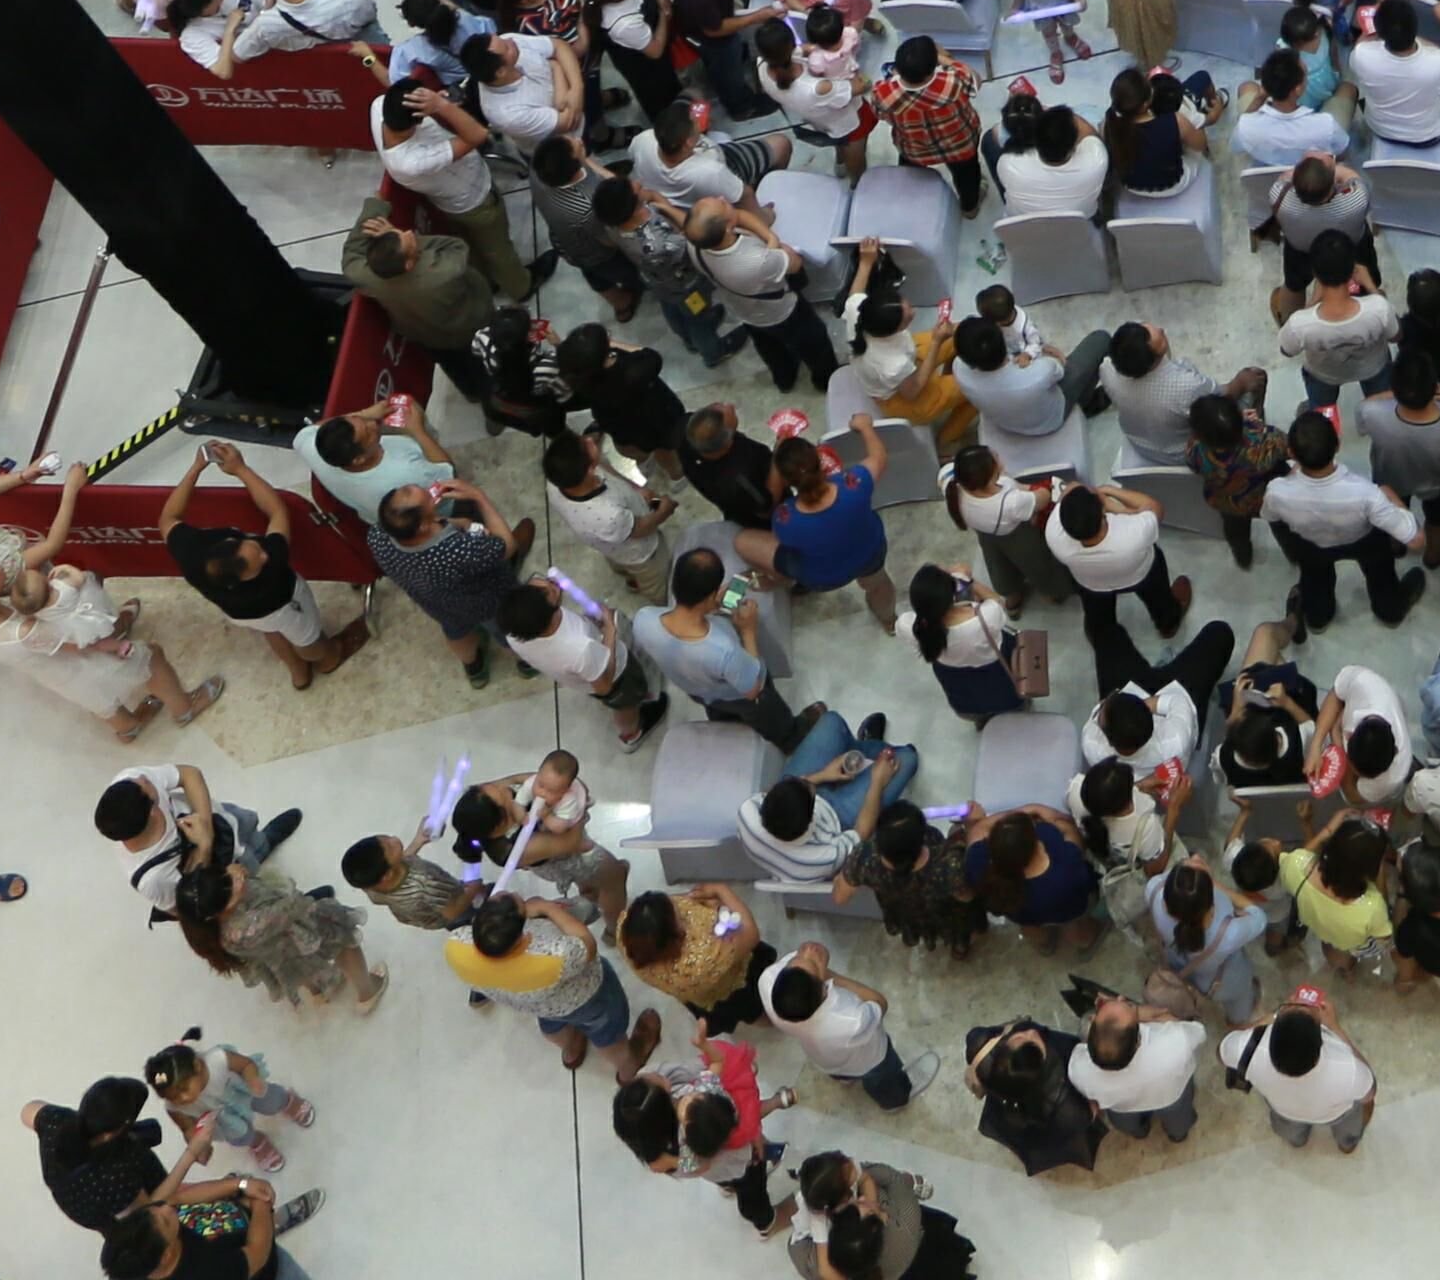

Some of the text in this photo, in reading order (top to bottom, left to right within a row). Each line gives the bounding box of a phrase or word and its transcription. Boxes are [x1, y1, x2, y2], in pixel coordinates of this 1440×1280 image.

[190, 86, 344, 105] 万达广场
[203, 101, 347, 111] WANDA PLAZA
[47, 524, 162, 541] 万达广
